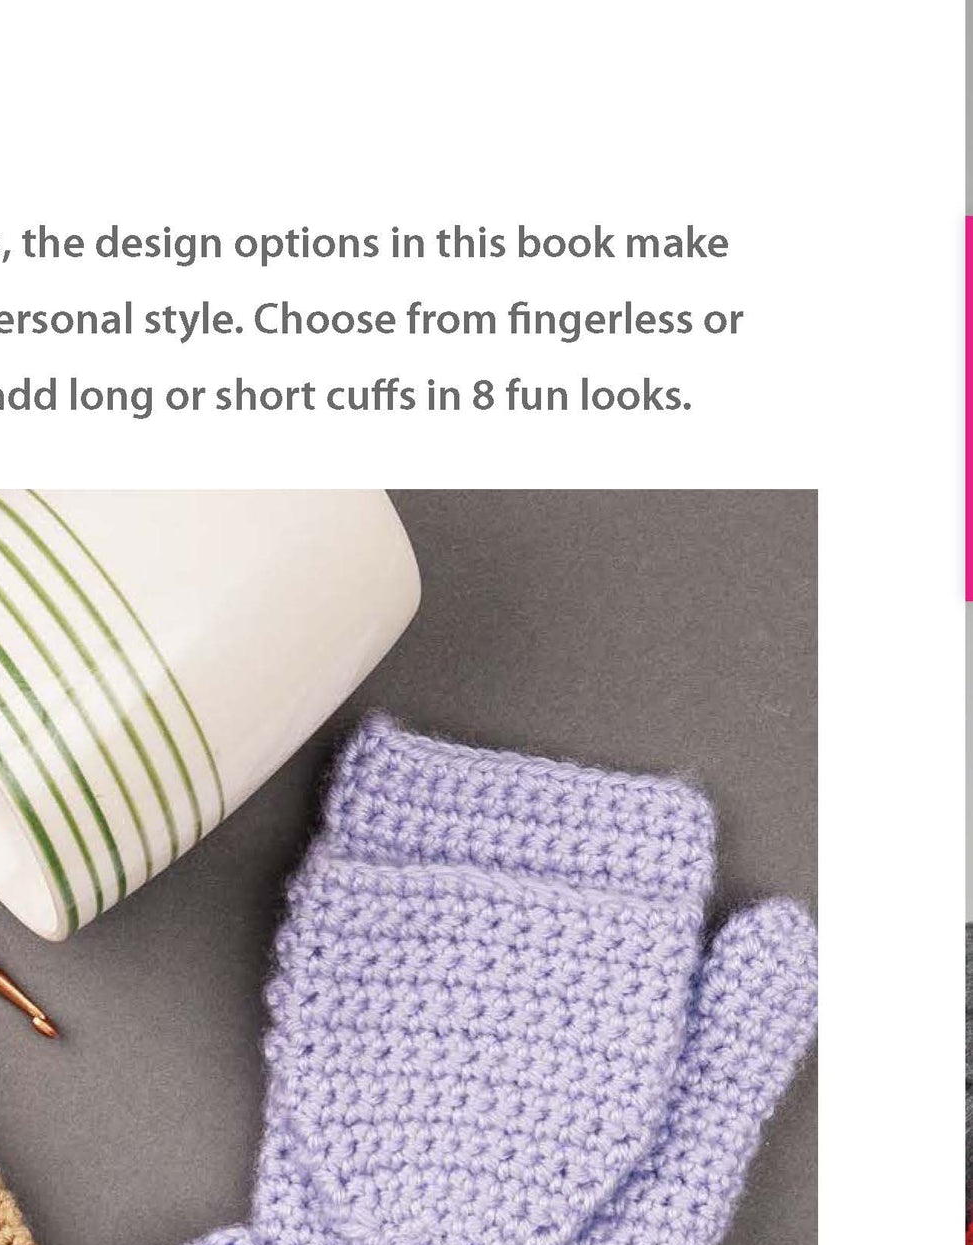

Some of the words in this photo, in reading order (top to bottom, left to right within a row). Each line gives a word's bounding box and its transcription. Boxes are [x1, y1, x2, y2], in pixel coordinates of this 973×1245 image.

[22, 225, 84, 257] the
[96, 225, 221, 266] design
[235, 227, 379, 266] options
[392, 227, 424, 257] in
[437, 225, 505, 257] this
[519, 225, 615, 257] book
[627, 225, 728, 257] make
[146, 301, 243, 343] style.
[255, 301, 395, 333] Choose
[407, 302, 495, 333] from
[508, 301, 692, 343] fingerless
[704, 311, 743, 333] or
[71, 378, 152, 419] long
[166, 388, 205, 410] or
[217, 378, 315, 410] short
[327, 378, 415, 410] cuffs
[428, 379, 459, 410] in
[473, 380, 494, 410] 8
[506, 378, 567, 410] fun
[582, 378, 691, 410] looks.
